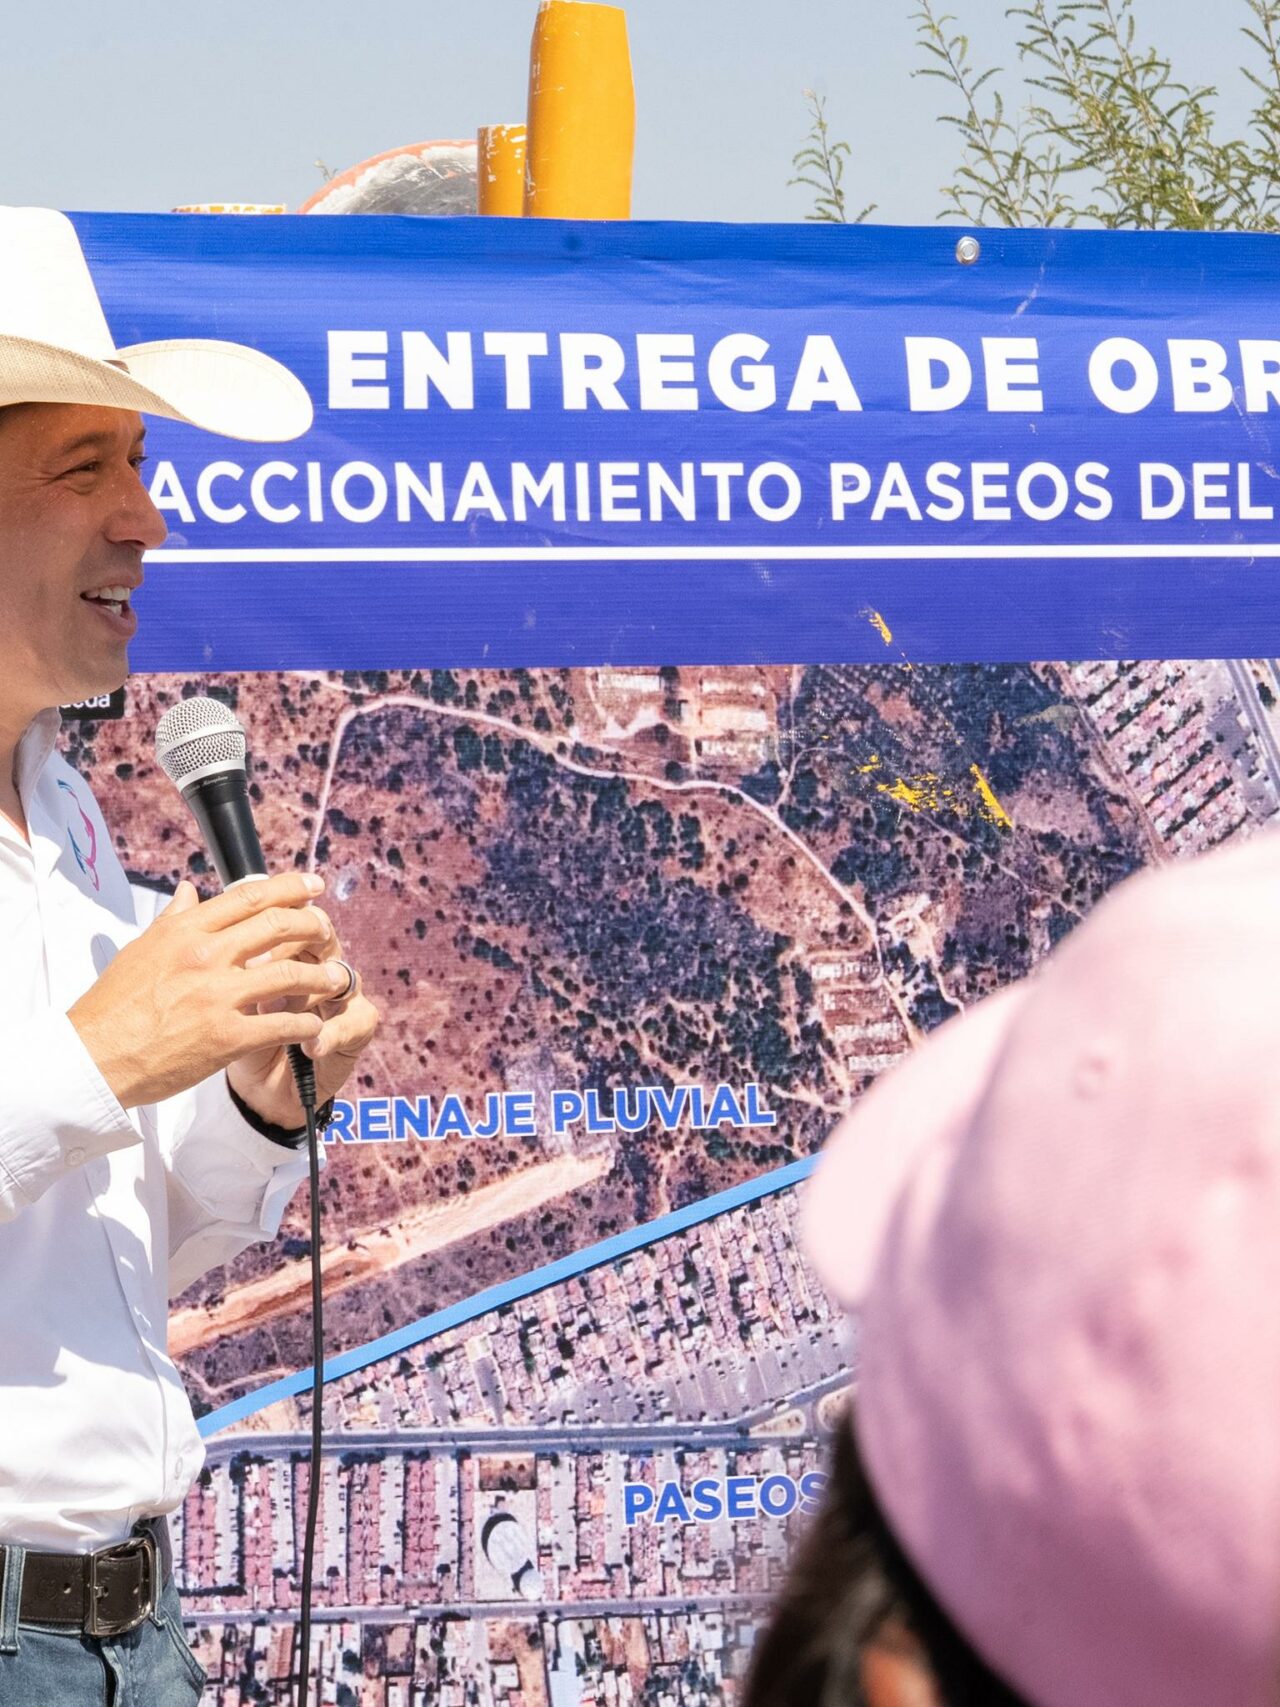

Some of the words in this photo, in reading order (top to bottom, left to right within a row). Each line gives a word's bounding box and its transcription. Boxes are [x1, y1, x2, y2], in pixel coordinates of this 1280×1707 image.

[327, 330, 863, 413] ENTREGA
[904, 336, 1043, 412] DE
[148, 461, 802, 523] ACCIONAMIENTO
[830, 461, 1113, 521] PASEOS
[1140, 462, 1273, 520] DEL
[323, 1092, 535, 1143] RENAJE
[552, 1085, 775, 1133] PLUVIAL
[624, 1472, 828, 1526] PASEOS
